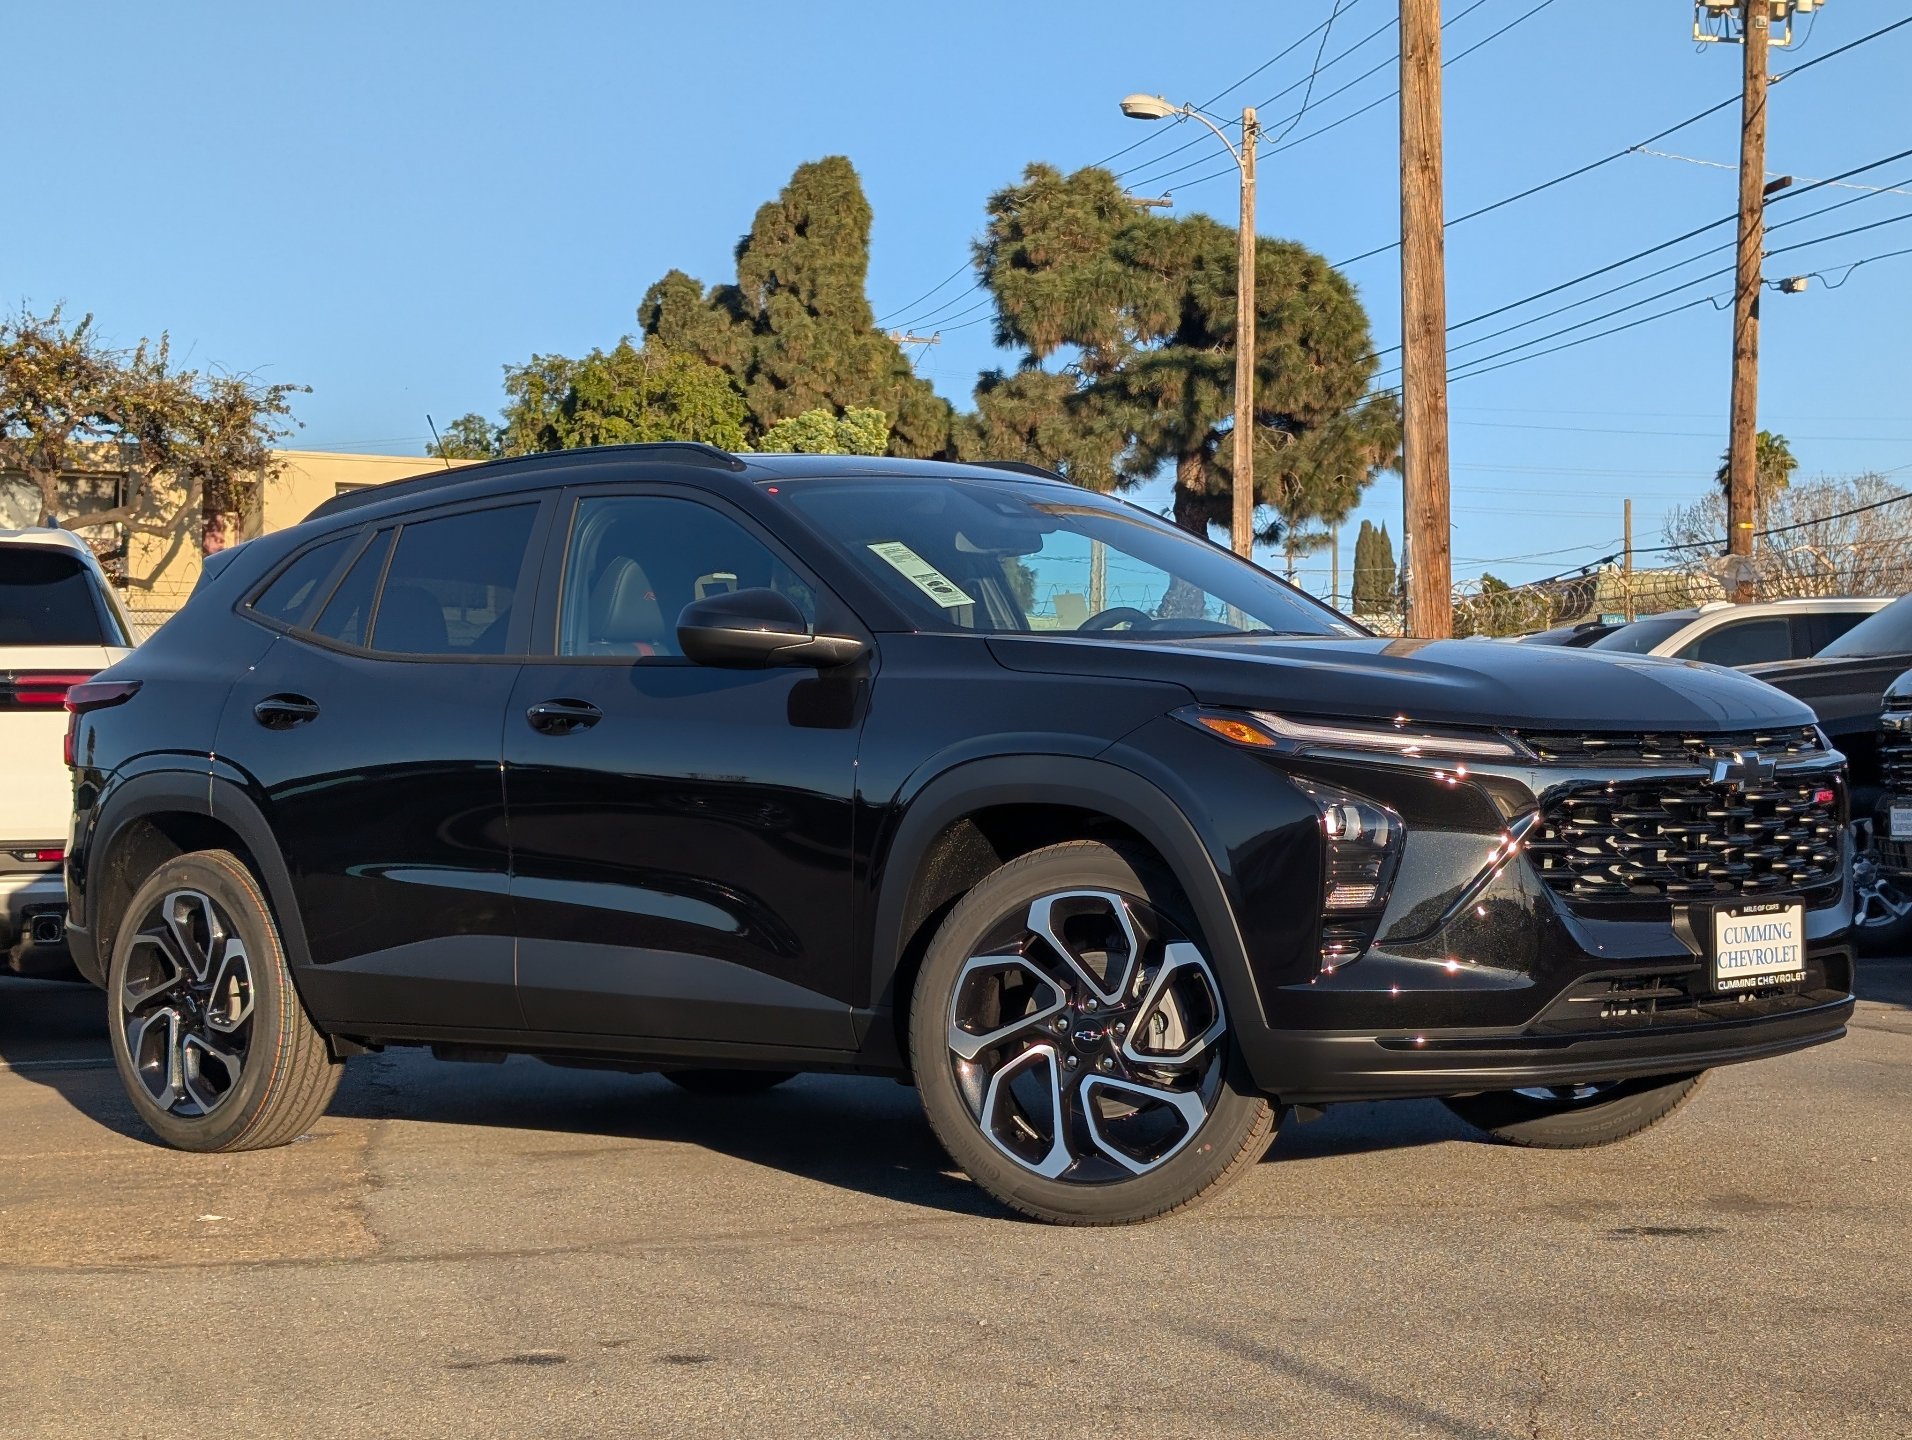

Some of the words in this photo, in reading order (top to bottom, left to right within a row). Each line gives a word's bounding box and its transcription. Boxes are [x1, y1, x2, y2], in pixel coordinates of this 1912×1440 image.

[1724, 922, 1792, 945] CUMMING
[1718, 944, 1798, 969] CHEVROLET
[1718, 978, 1756, 991] CUMMING
[1757, 971, 1806, 985] CHEVROLET
